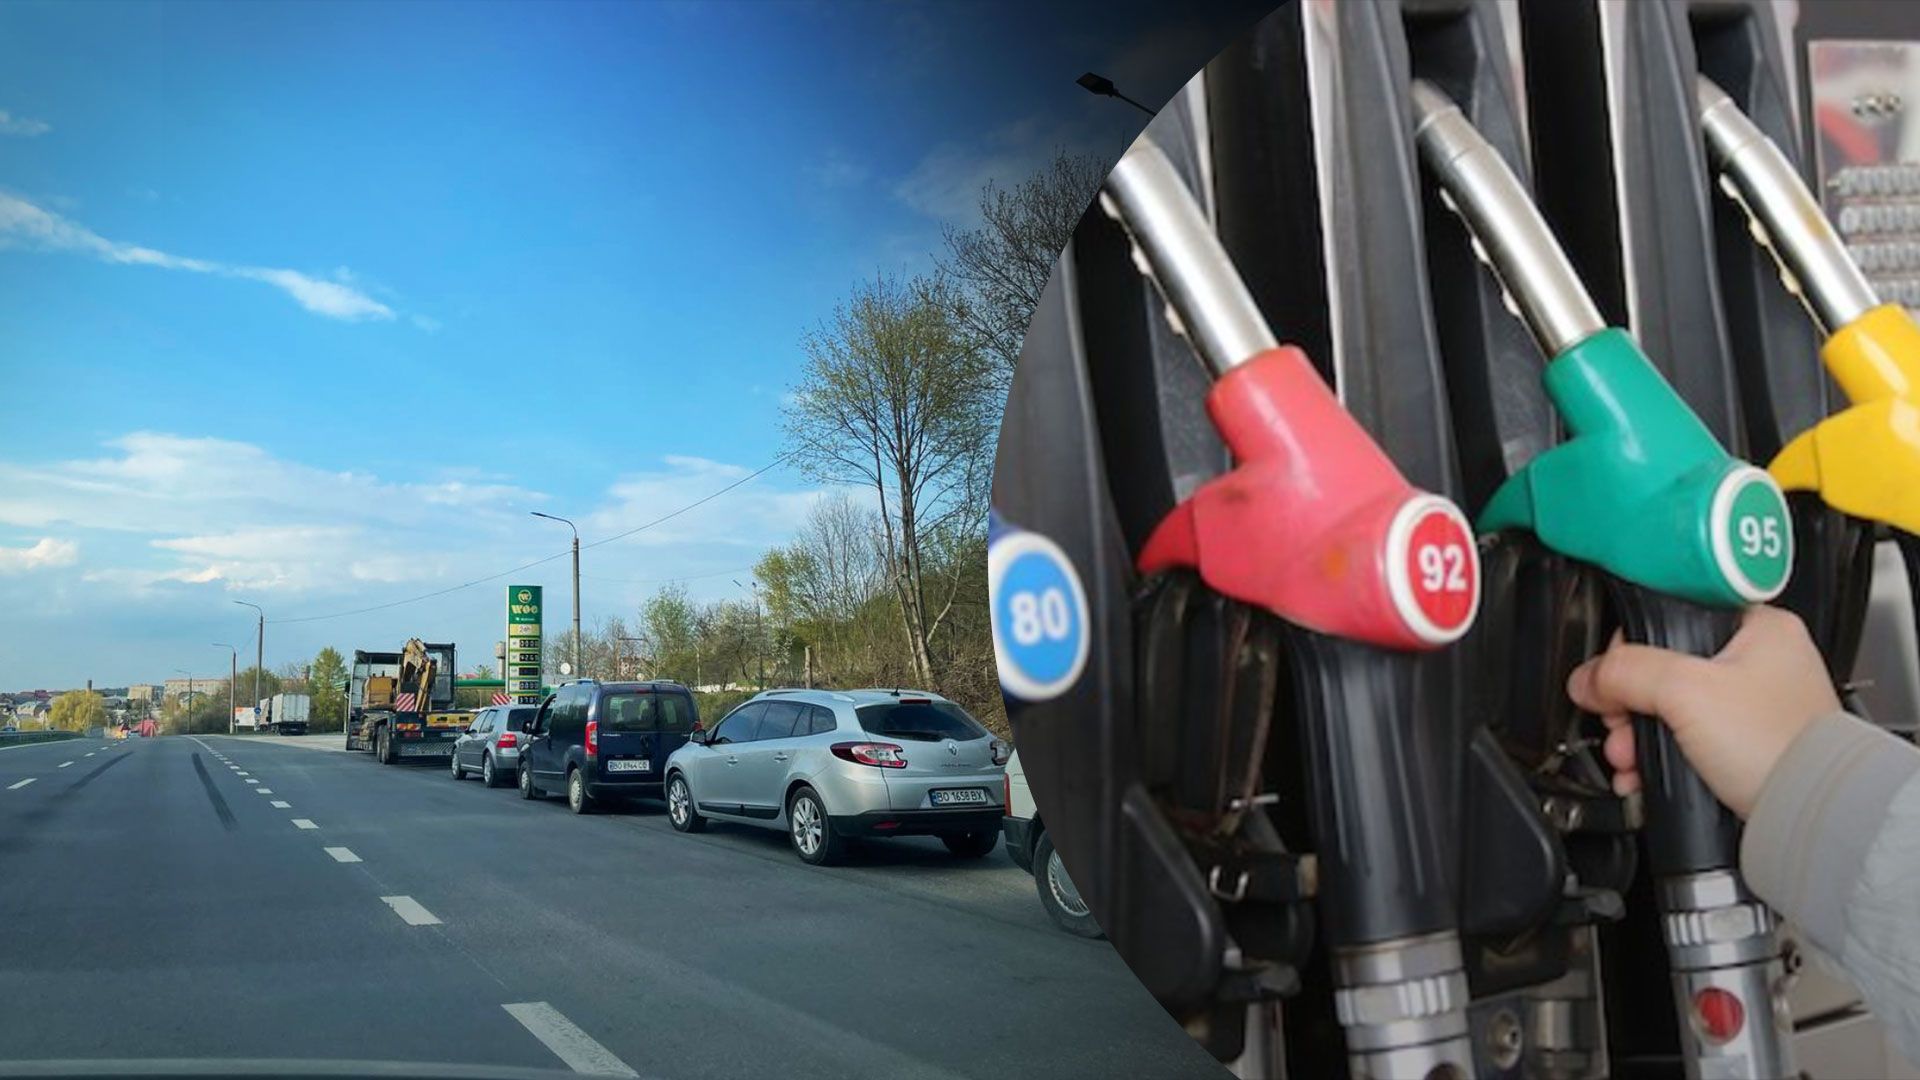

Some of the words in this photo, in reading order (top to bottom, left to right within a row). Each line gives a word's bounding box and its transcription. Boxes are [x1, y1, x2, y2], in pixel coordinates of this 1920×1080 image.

[1740, 515, 1782, 558] 95
[1418, 544, 1468, 592] 92
[1010, 587, 1069, 646] 80
[937, 791, 949, 802] BO
[951, 791, 970, 801] 1658
